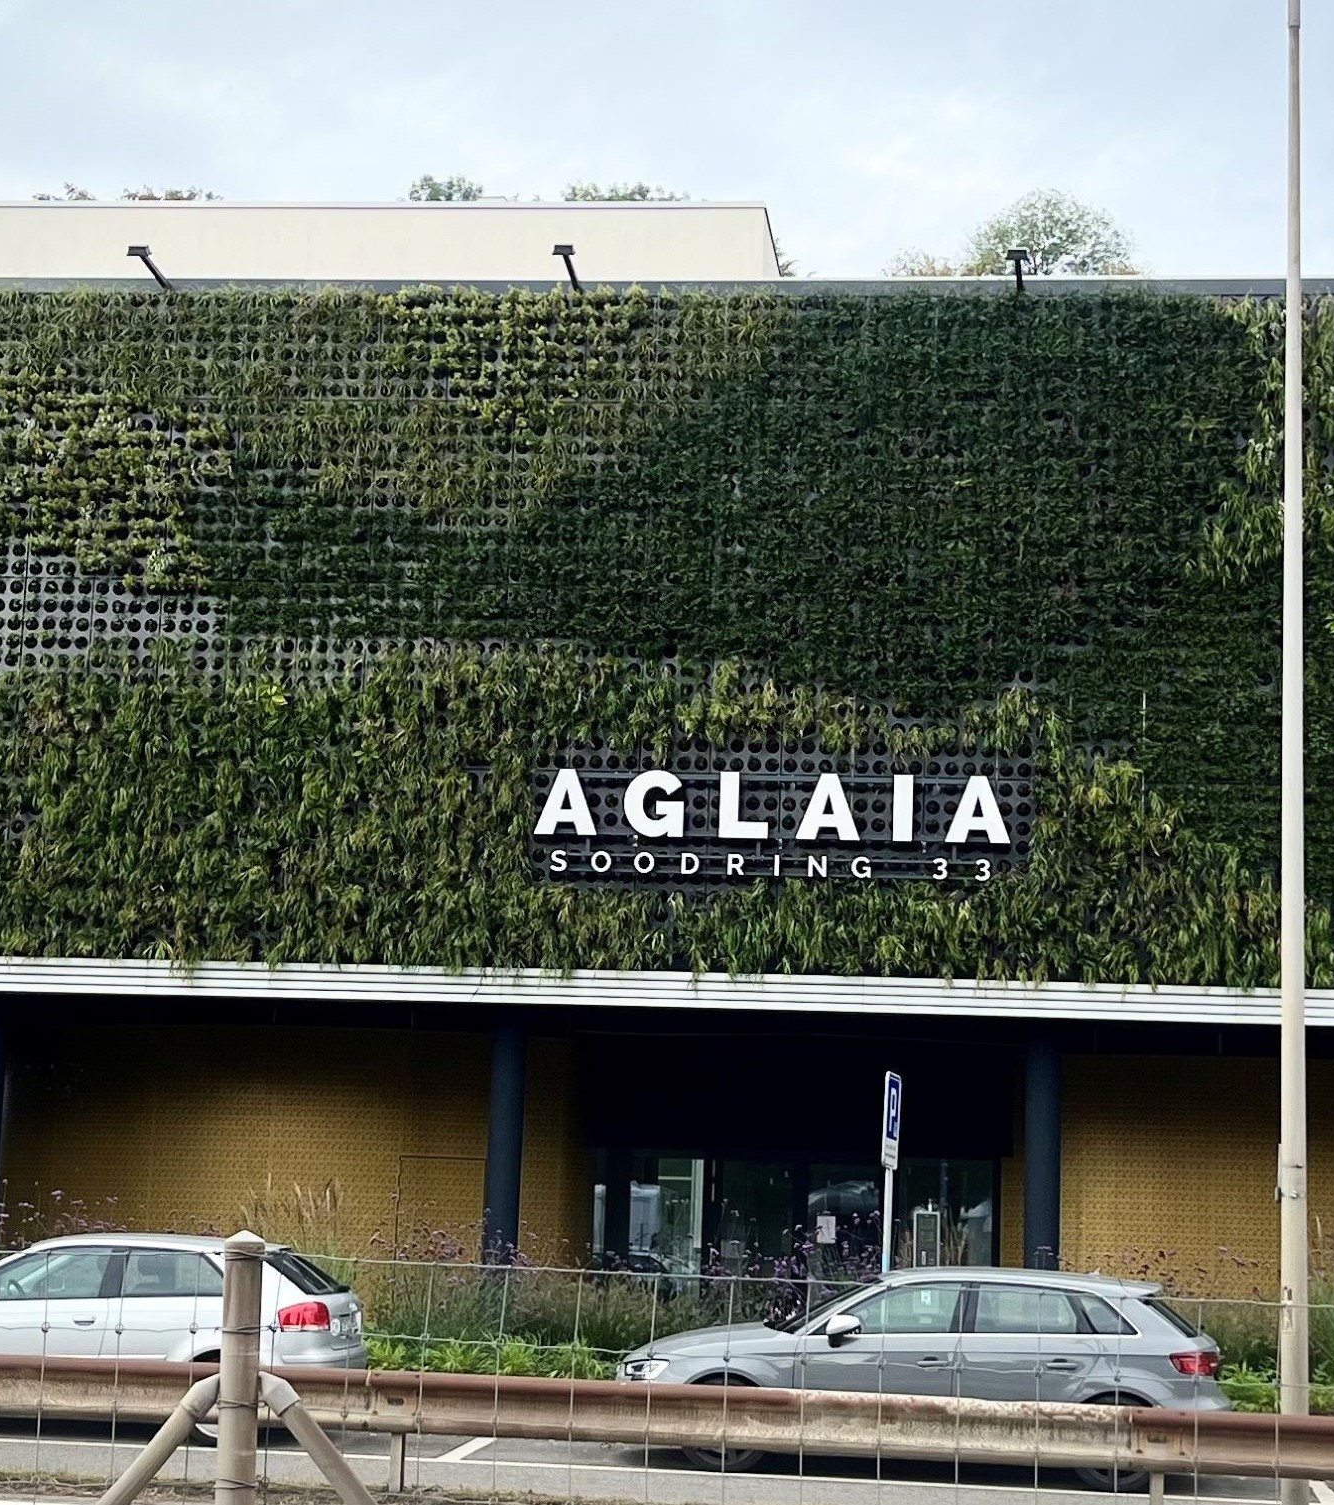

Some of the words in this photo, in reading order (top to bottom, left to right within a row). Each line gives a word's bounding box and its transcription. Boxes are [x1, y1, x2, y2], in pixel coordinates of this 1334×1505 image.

[533, 768, 1011, 844] AGLAIA
[549, 849, 872, 879] SOODRING
[932, 857, 991, 882] 33
[888, 1087, 897, 1132] P
